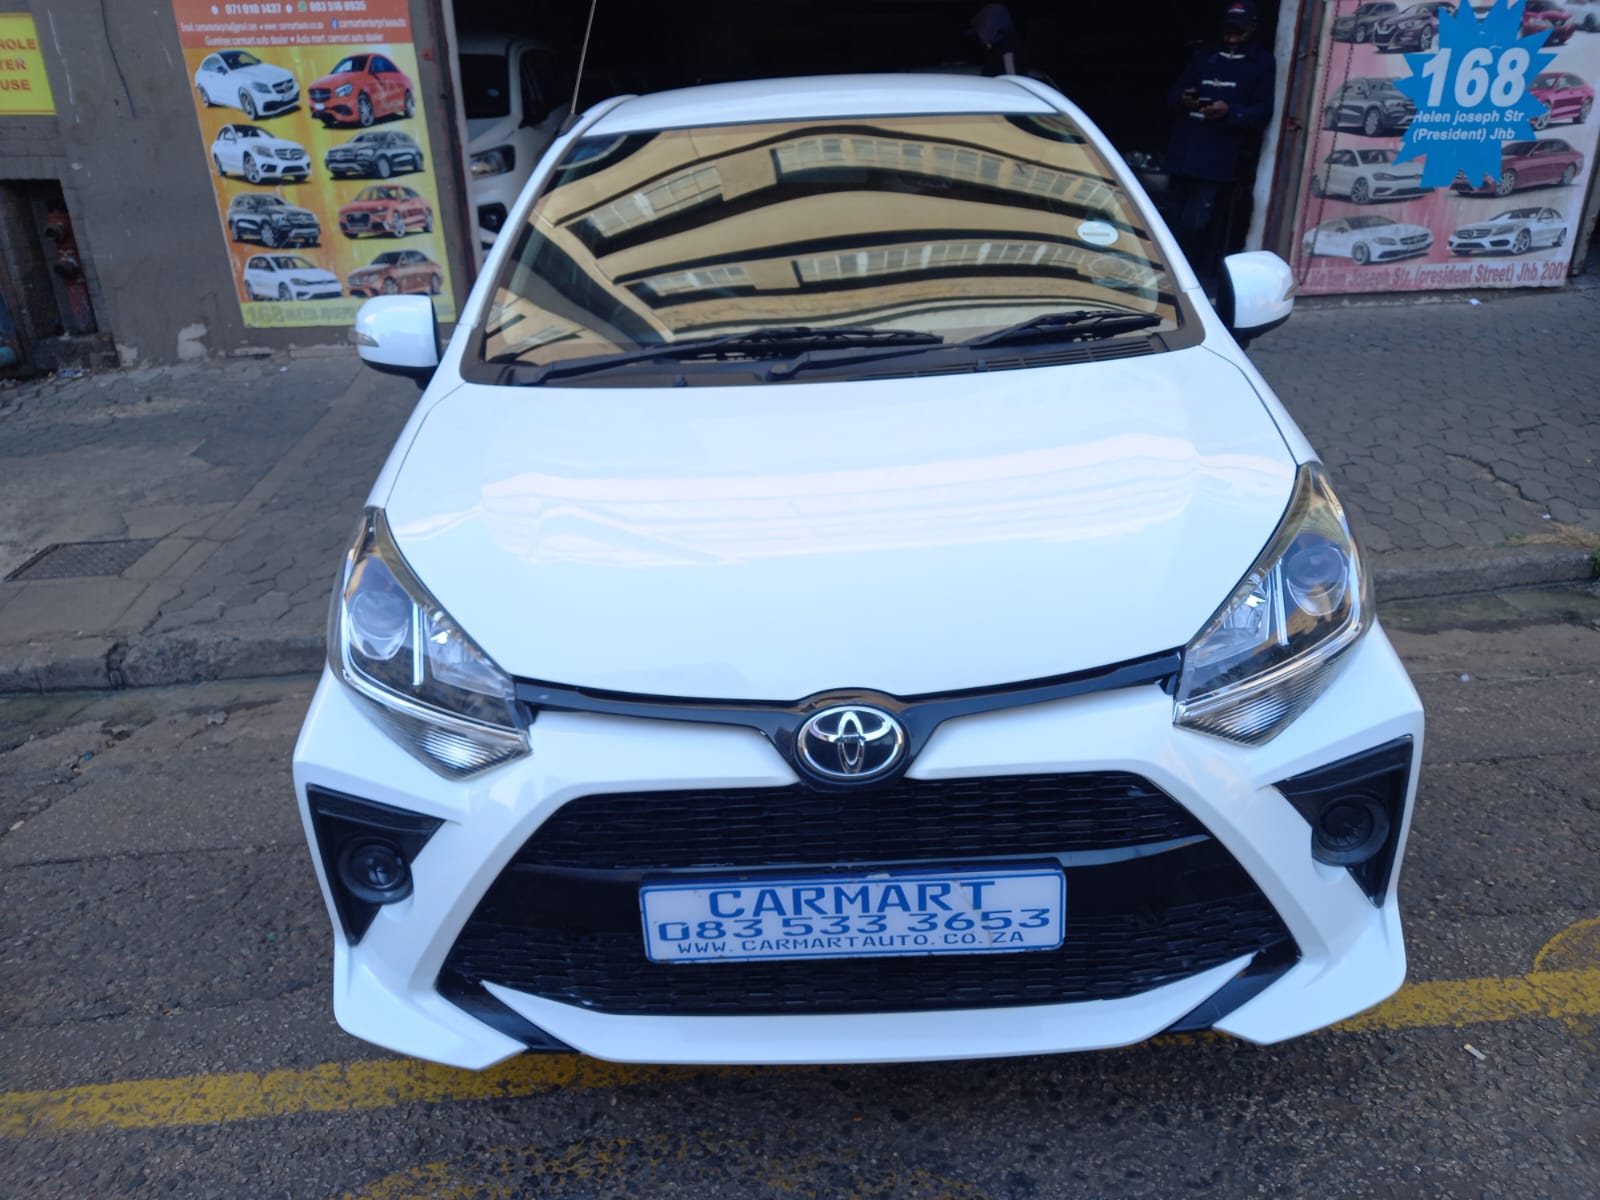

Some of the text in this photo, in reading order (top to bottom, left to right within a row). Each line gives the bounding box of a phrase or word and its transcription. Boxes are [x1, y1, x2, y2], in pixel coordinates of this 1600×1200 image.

[1422, 47, 1530, 107] 168
[1413, 109, 1525, 125] Helen joseph Str
[1412, 128, 1516, 142] (President) Jhb
[1475, 262, 1514, 283] Street)
[1517, 261, 1538, 281] Jhb
[709, 881, 995, 918] CARMART
[658, 908, 1050, 941] 083 533 3653
